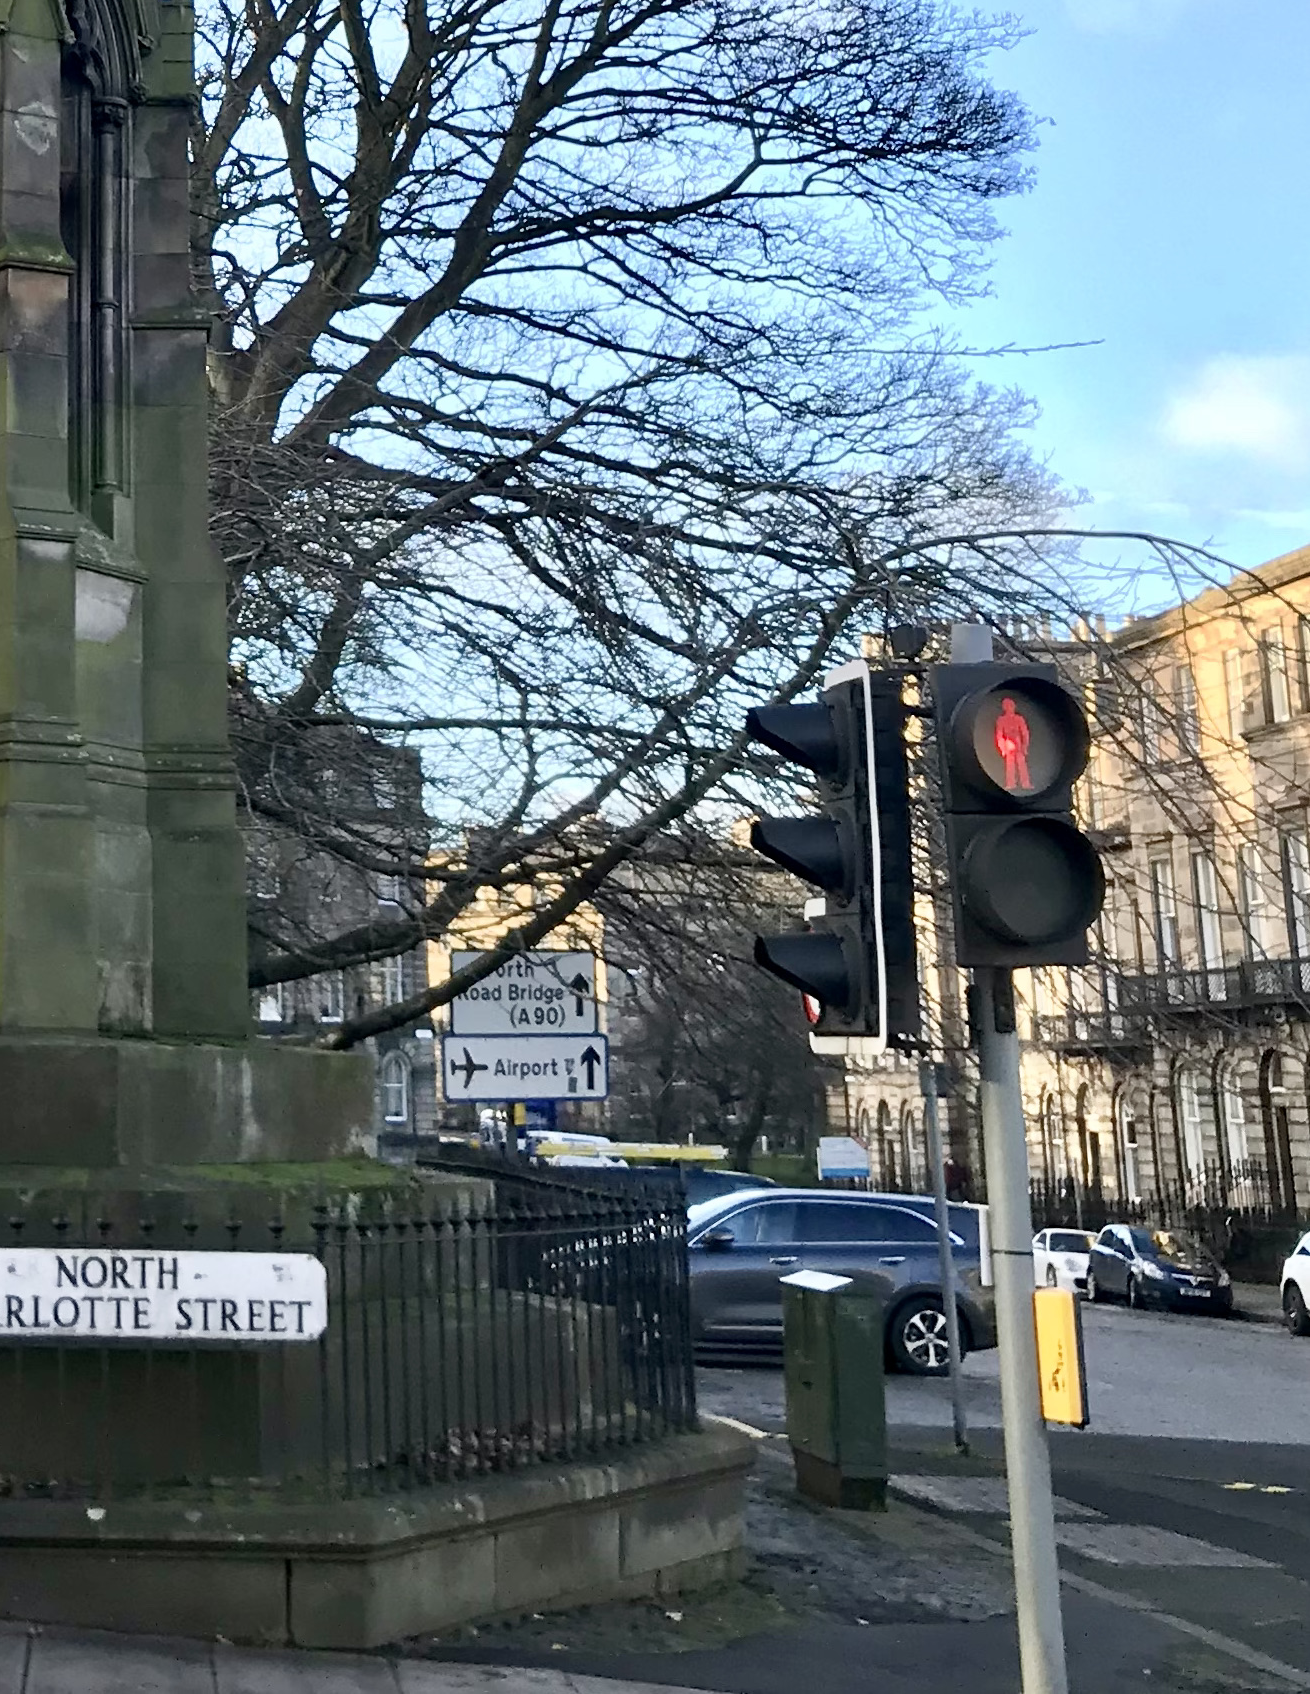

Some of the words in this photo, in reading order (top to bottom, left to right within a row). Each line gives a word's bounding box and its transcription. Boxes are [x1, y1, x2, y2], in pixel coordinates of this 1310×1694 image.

[495, 959, 534, 978] orth
[508, 983, 564, 1005] Bridge
[494, 1058, 558, 1080] Airport
[56, 1256, 179, 1289] NORTH
[176, 1297, 312, 1333] STREET
